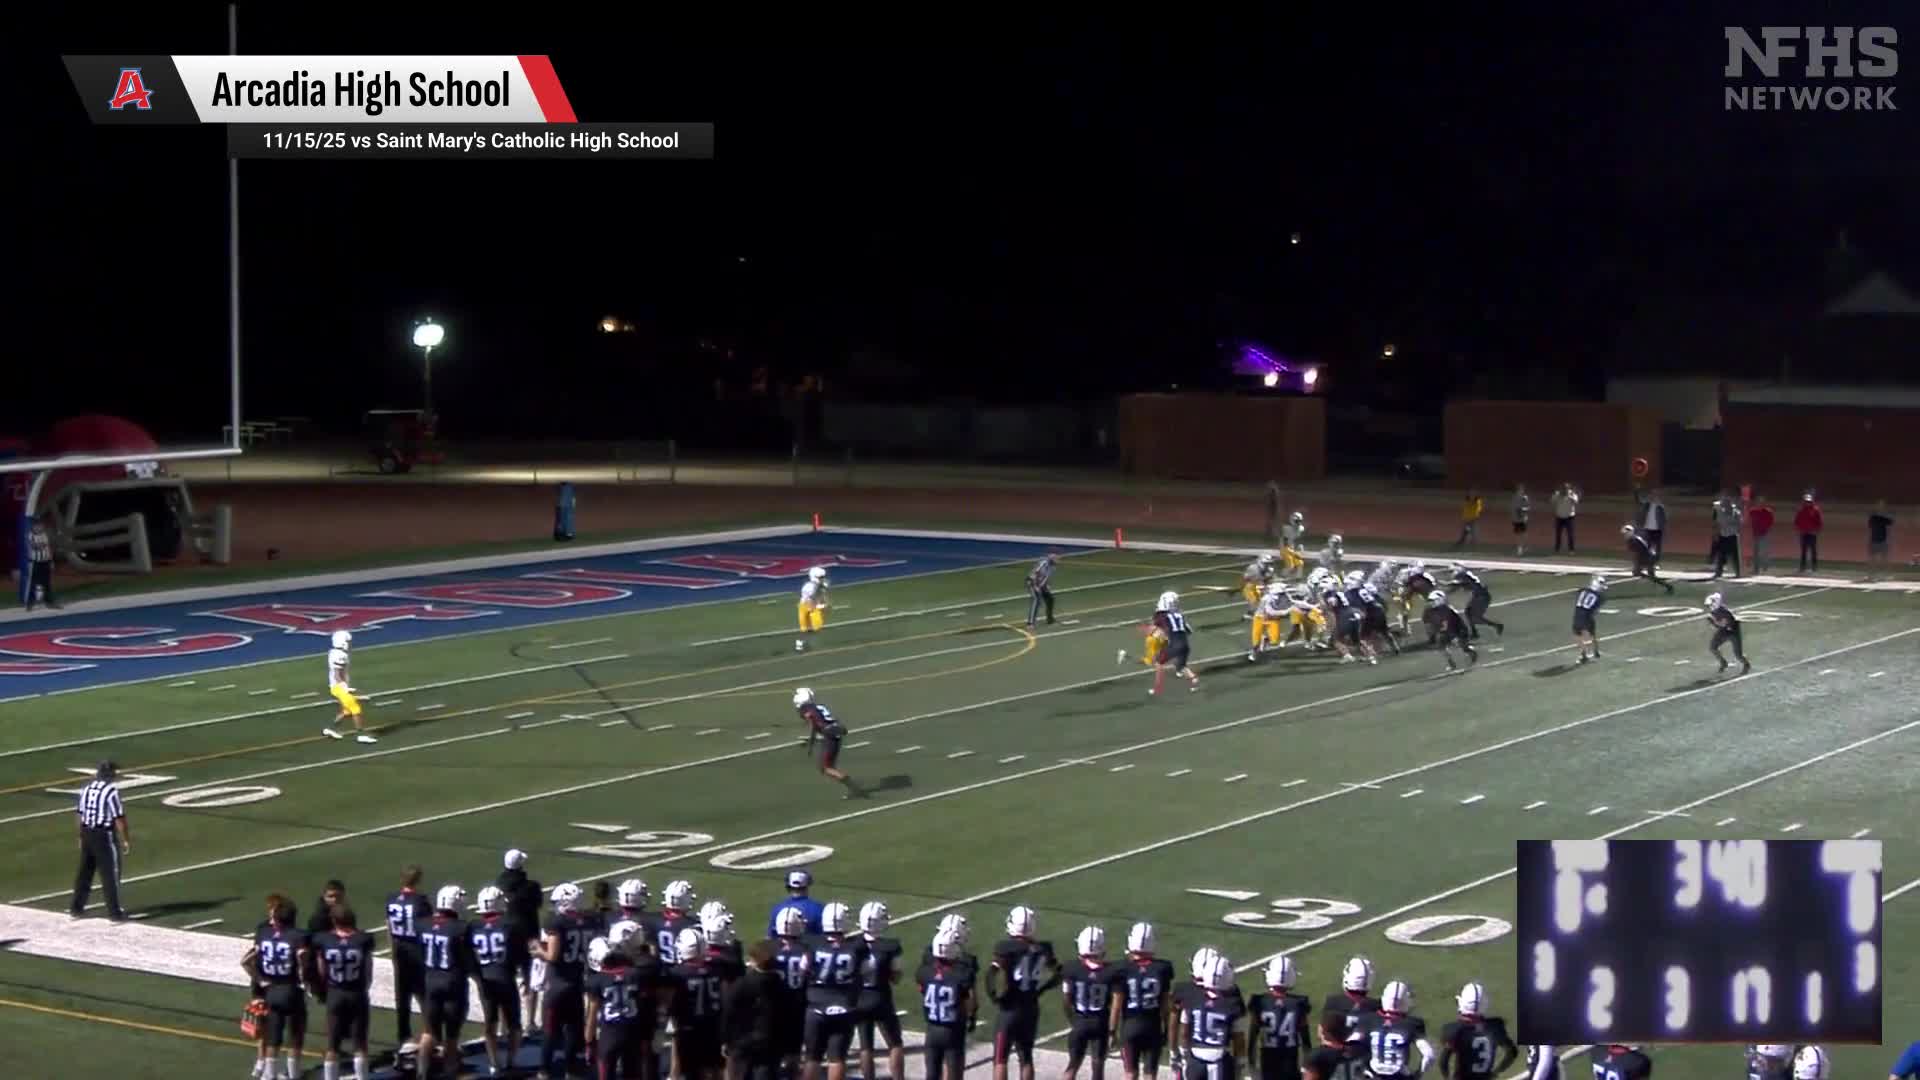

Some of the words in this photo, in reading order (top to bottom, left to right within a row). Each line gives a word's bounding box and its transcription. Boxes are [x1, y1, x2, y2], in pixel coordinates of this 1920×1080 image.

[1576, 591, 1598, 609] 10
[387, 905, 416, 937] 21
[260, 941, 292, 976] 23
[326, 949, 362, 983] 22
[422, 933, 449, 969] 77
[815, 951, 855, 985] 72
[924, 984, 957, 1022] 42
[1127, 977, 1161, 1009] 12
[1191, 1009, 1226, 1045] 15
[1260, 1011, 1297, 1048] 24
[1370, 1032, 1405, 1075] 16
[1472, 1037, 1492, 1073] 3
